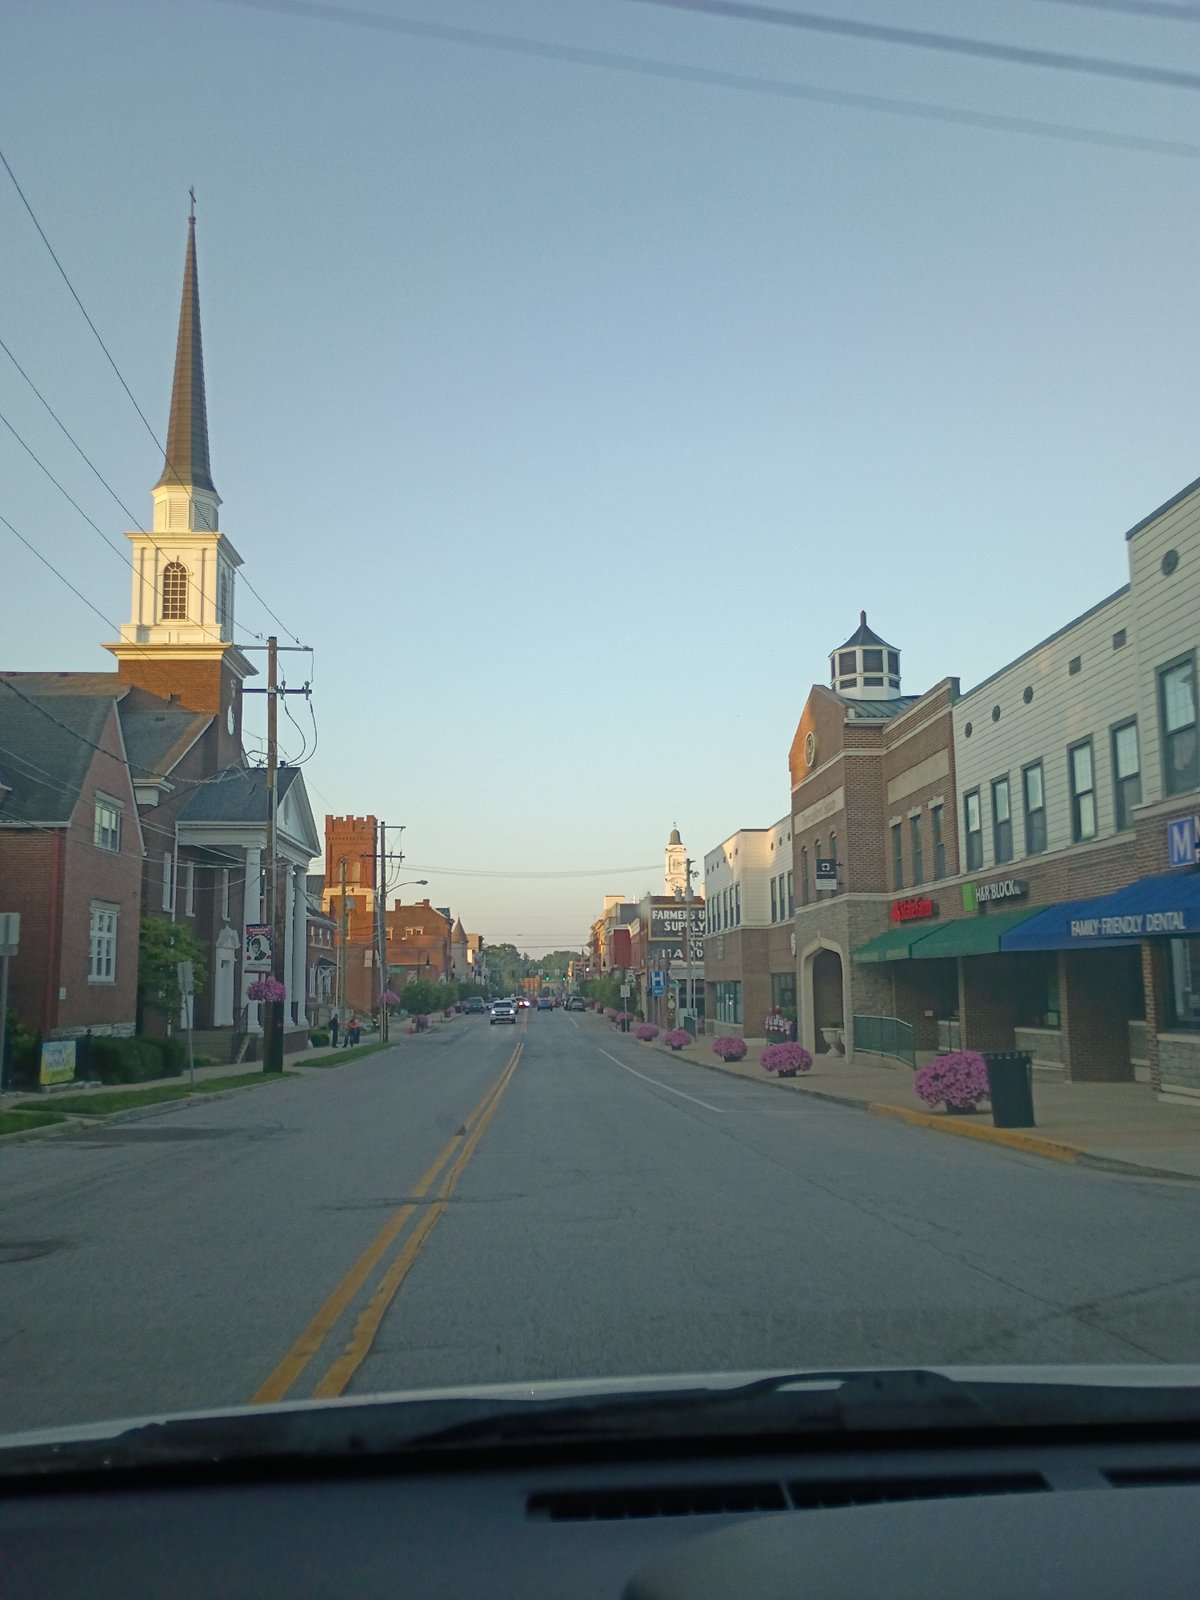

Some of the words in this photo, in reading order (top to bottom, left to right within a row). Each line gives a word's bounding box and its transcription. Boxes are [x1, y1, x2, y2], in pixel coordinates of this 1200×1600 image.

[975, 885, 990, 902] H&R
[991, 879, 1015, 899] BLOCK
[1146, 911, 1186, 932] DENTAL
[651, 970, 664, 986] H
